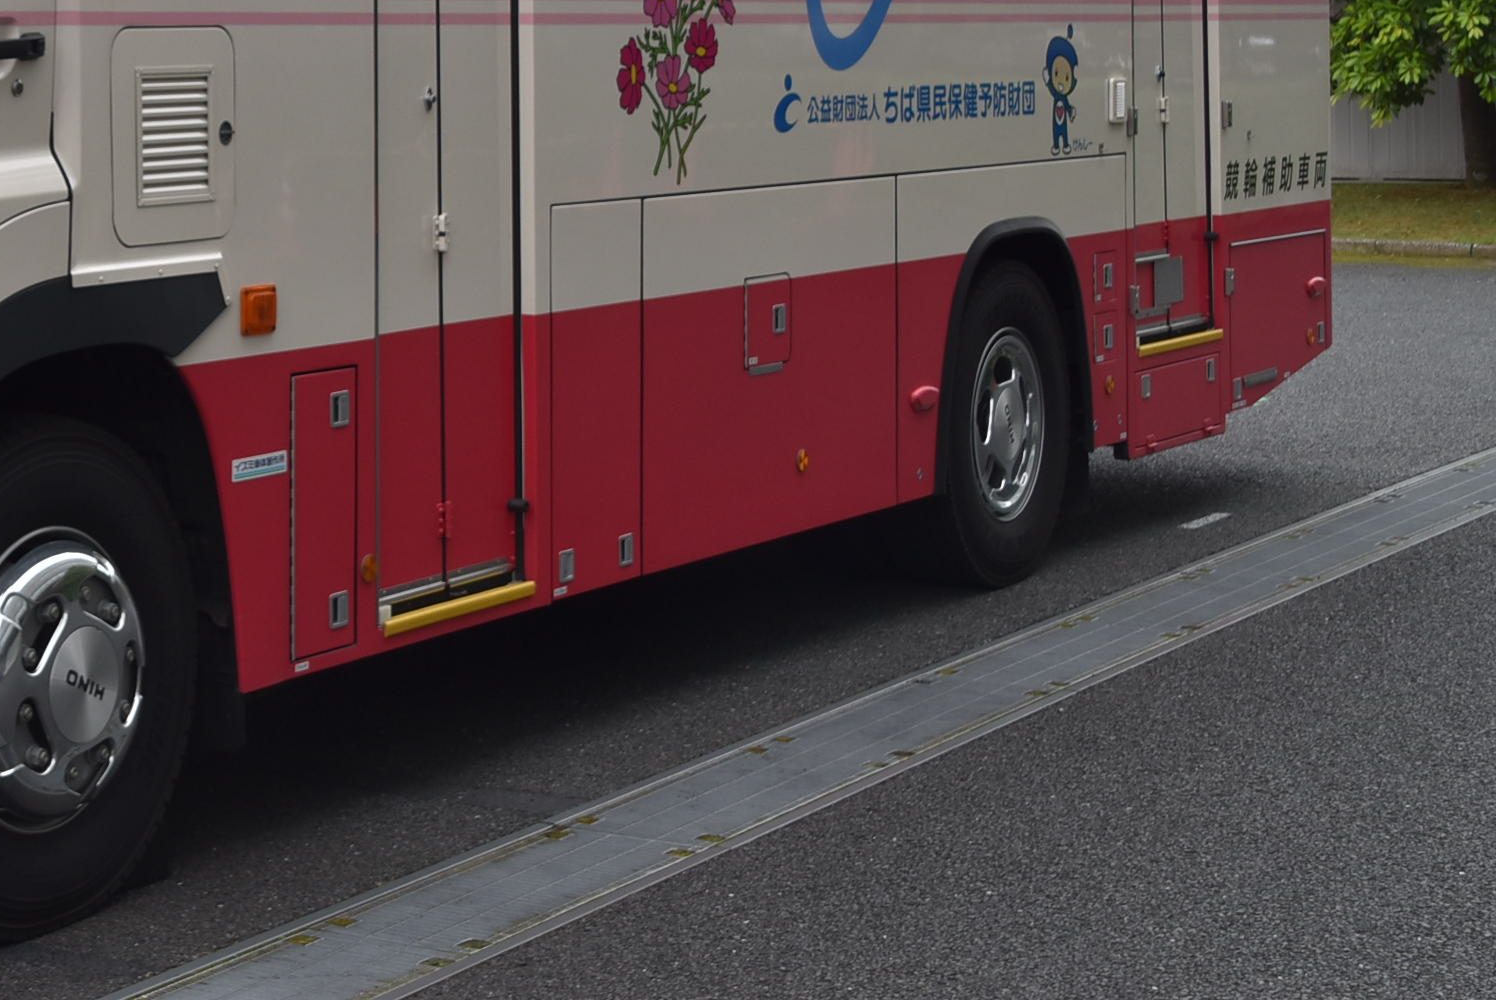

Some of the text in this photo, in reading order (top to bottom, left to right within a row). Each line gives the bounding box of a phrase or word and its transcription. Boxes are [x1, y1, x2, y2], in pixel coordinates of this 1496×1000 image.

[807, 81, 1036, 124] 公益財団法人 ちば県民保健予防財団
[1224, 151, 1328, 200] 競輪補助車両
[66, 669, 105, 701] HINO
